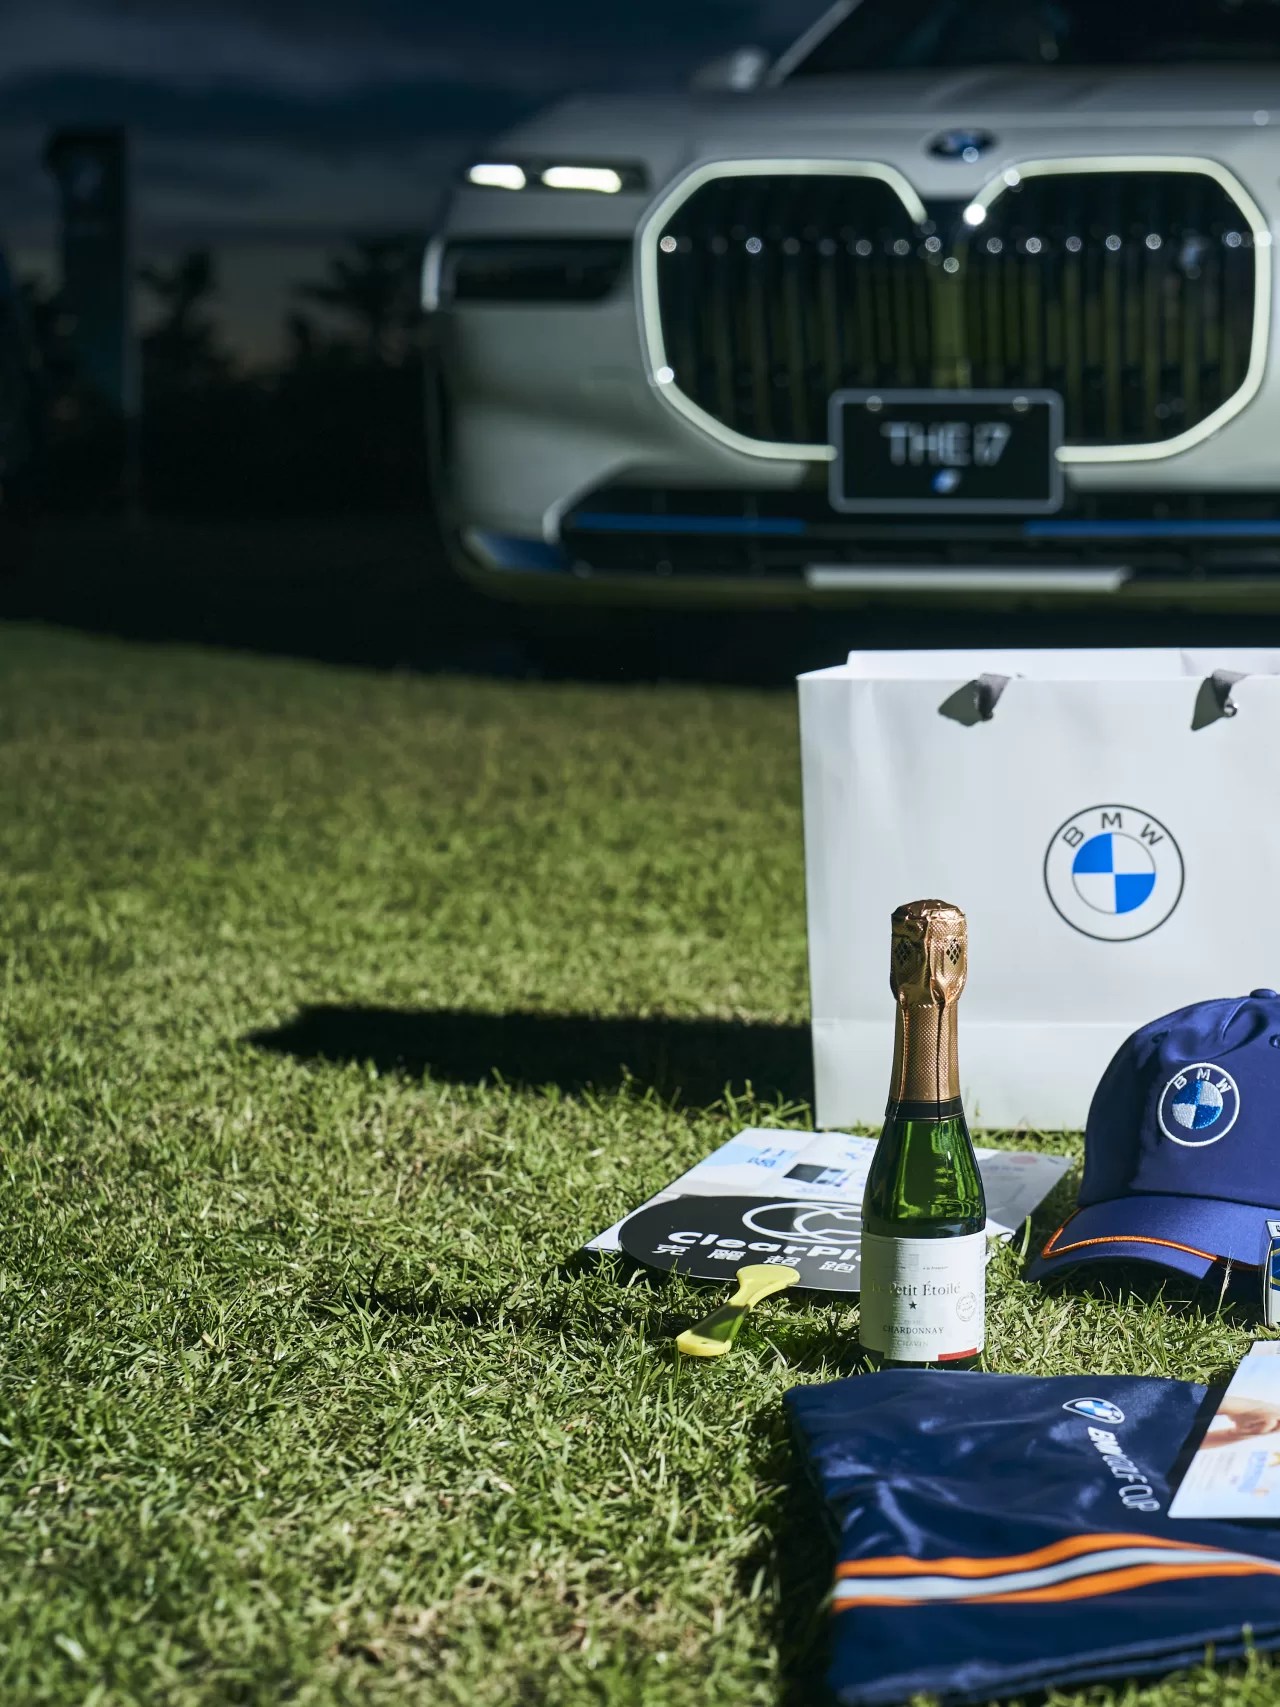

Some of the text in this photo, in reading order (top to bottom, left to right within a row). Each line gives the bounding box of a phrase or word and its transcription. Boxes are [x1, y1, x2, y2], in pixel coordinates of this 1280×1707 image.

[880, 421, 971, 466] THE
[1062, 812, 1164, 848] BMW
[1173, 1067, 1232, 1093] BMW
[668, 1231, 862, 1262] ClearPl
[882, 1323, 945, 1335] CHARDONNAY
